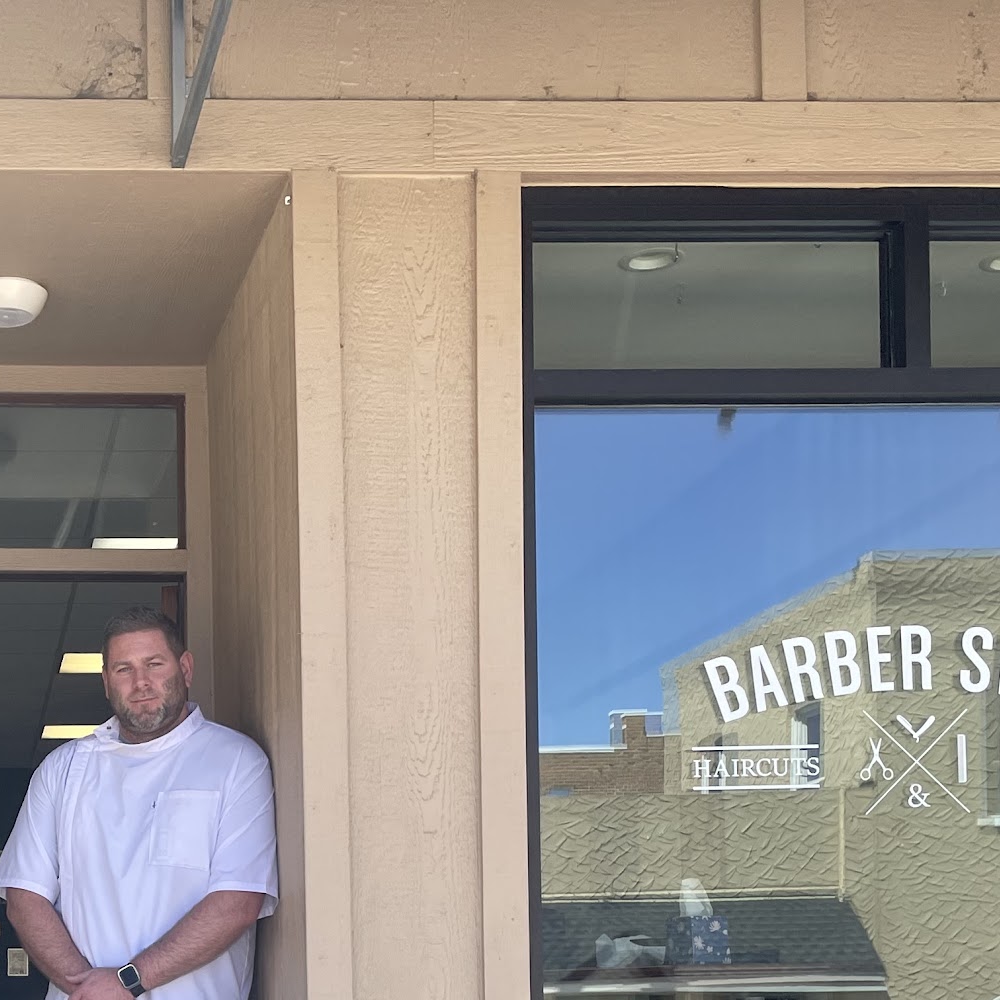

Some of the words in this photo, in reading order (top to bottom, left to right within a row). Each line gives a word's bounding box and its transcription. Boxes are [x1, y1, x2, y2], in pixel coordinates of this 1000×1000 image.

[703, 625, 933, 723] BARBER
[959, 626, 1000, 695] S
[692, 756, 820, 778] HAIRCUTS
[907, 783, 931, 807] &
